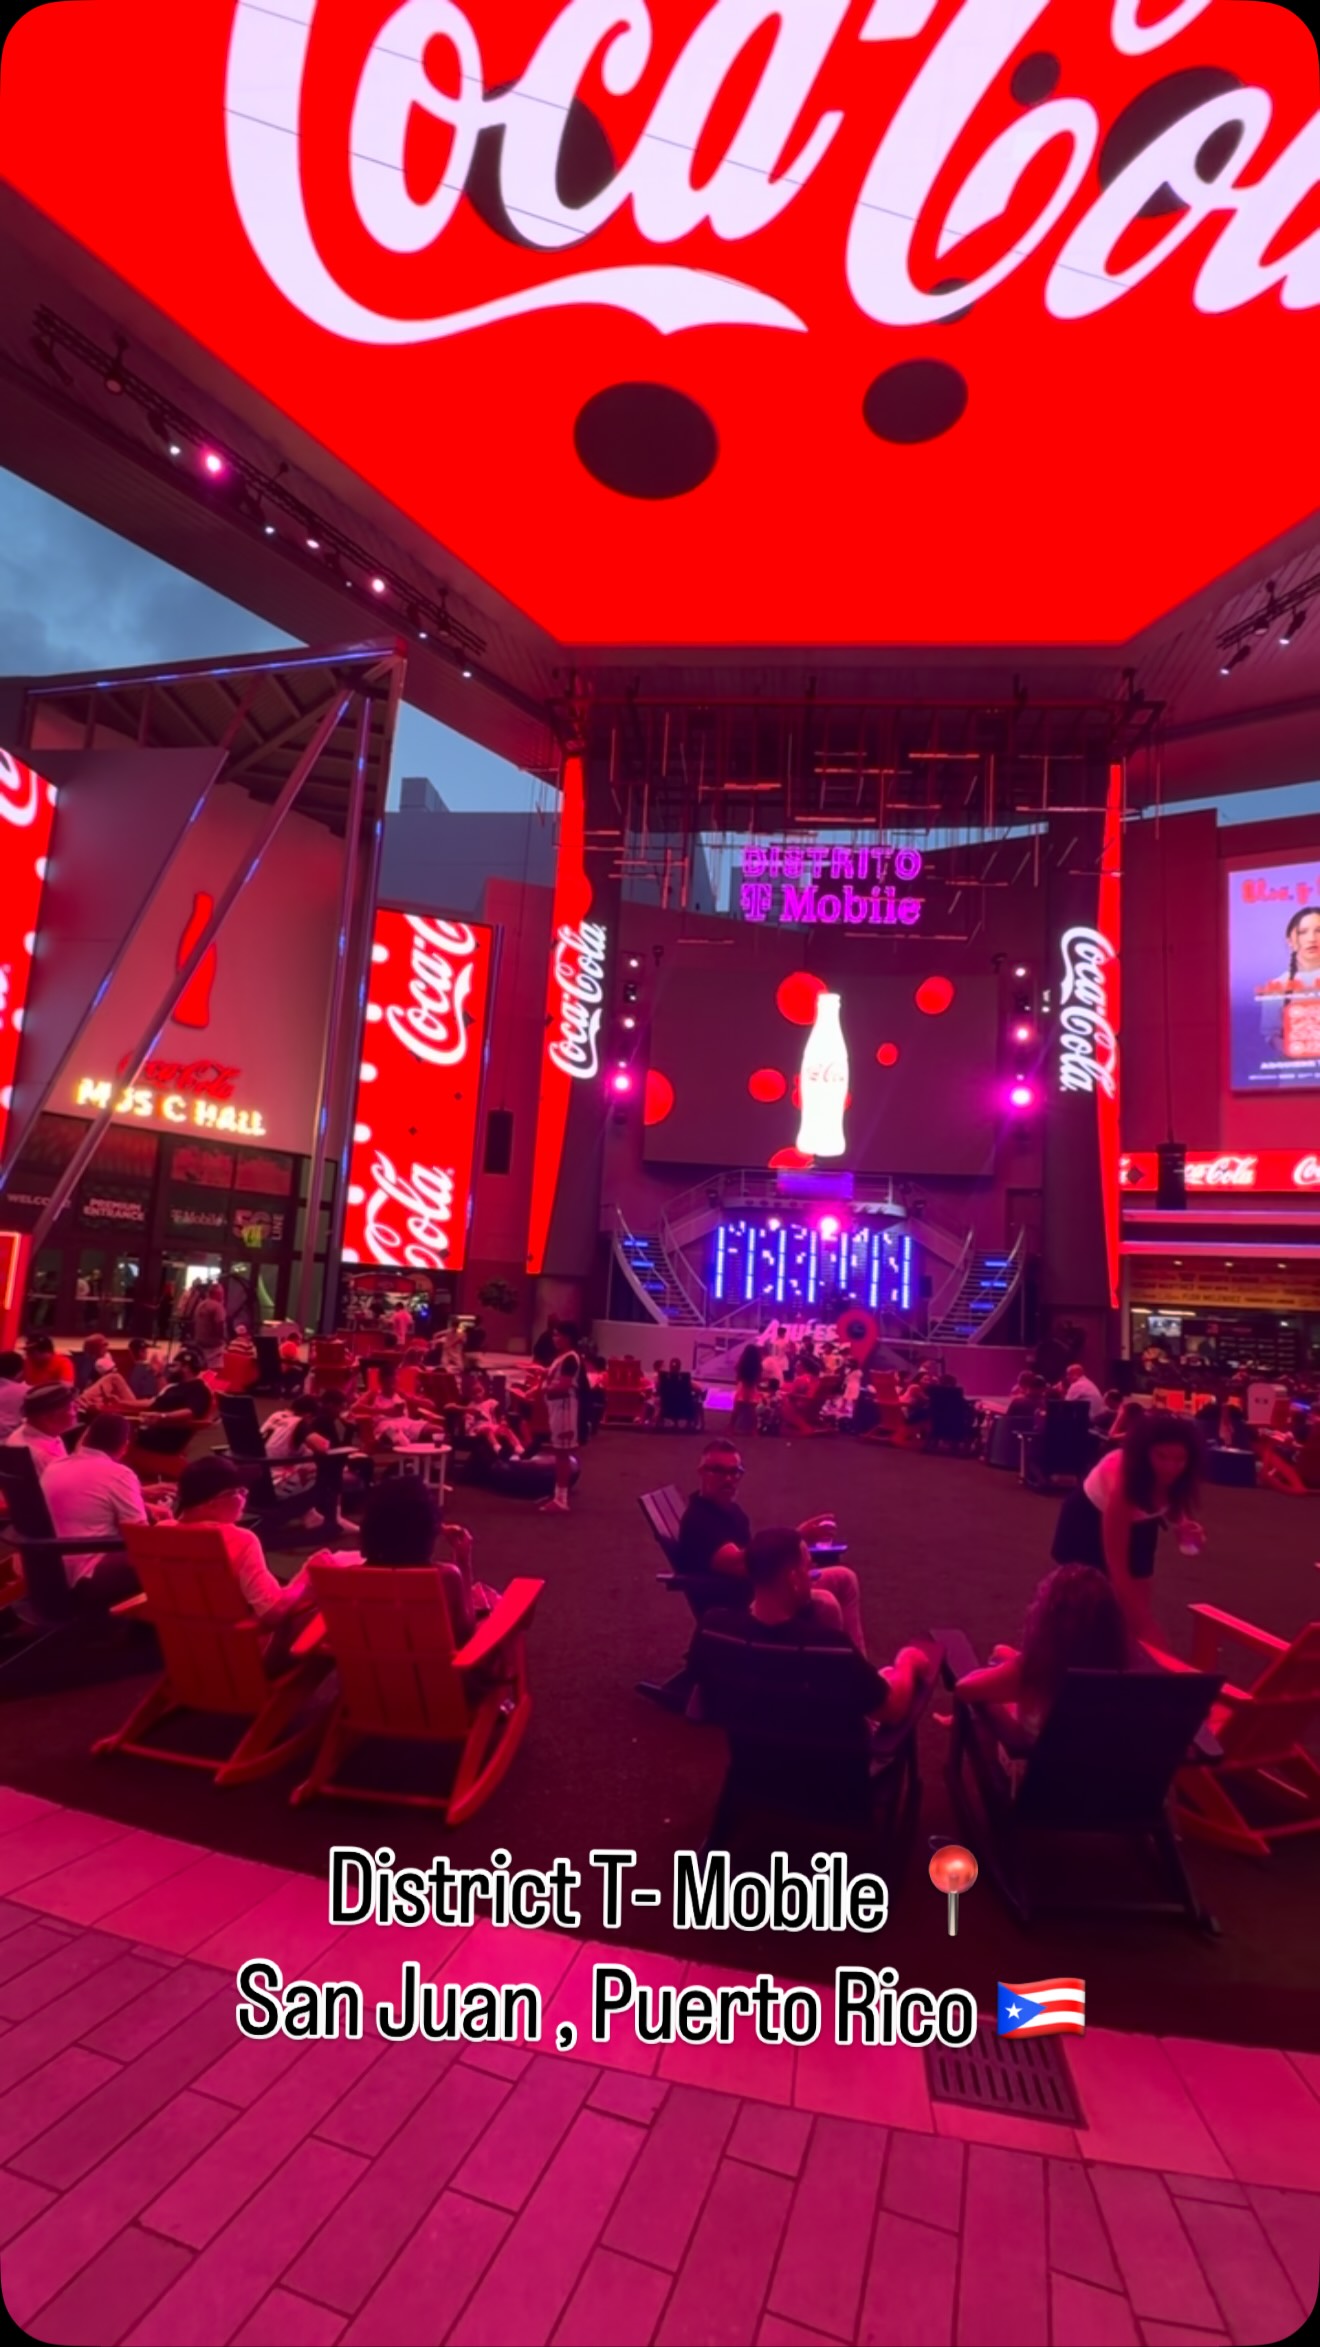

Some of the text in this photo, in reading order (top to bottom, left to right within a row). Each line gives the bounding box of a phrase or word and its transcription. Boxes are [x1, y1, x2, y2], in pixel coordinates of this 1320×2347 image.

[742, 846, 922, 880] DISTRITO
[779, 884, 921, 925] Mobile
[194, 1098, 267, 1137] HALL
[83, 1205, 145, 1222] ENTRANCE
[89, 1197, 142, 1212] PREMIUM
[272, 1213, 284, 1241] LINE
